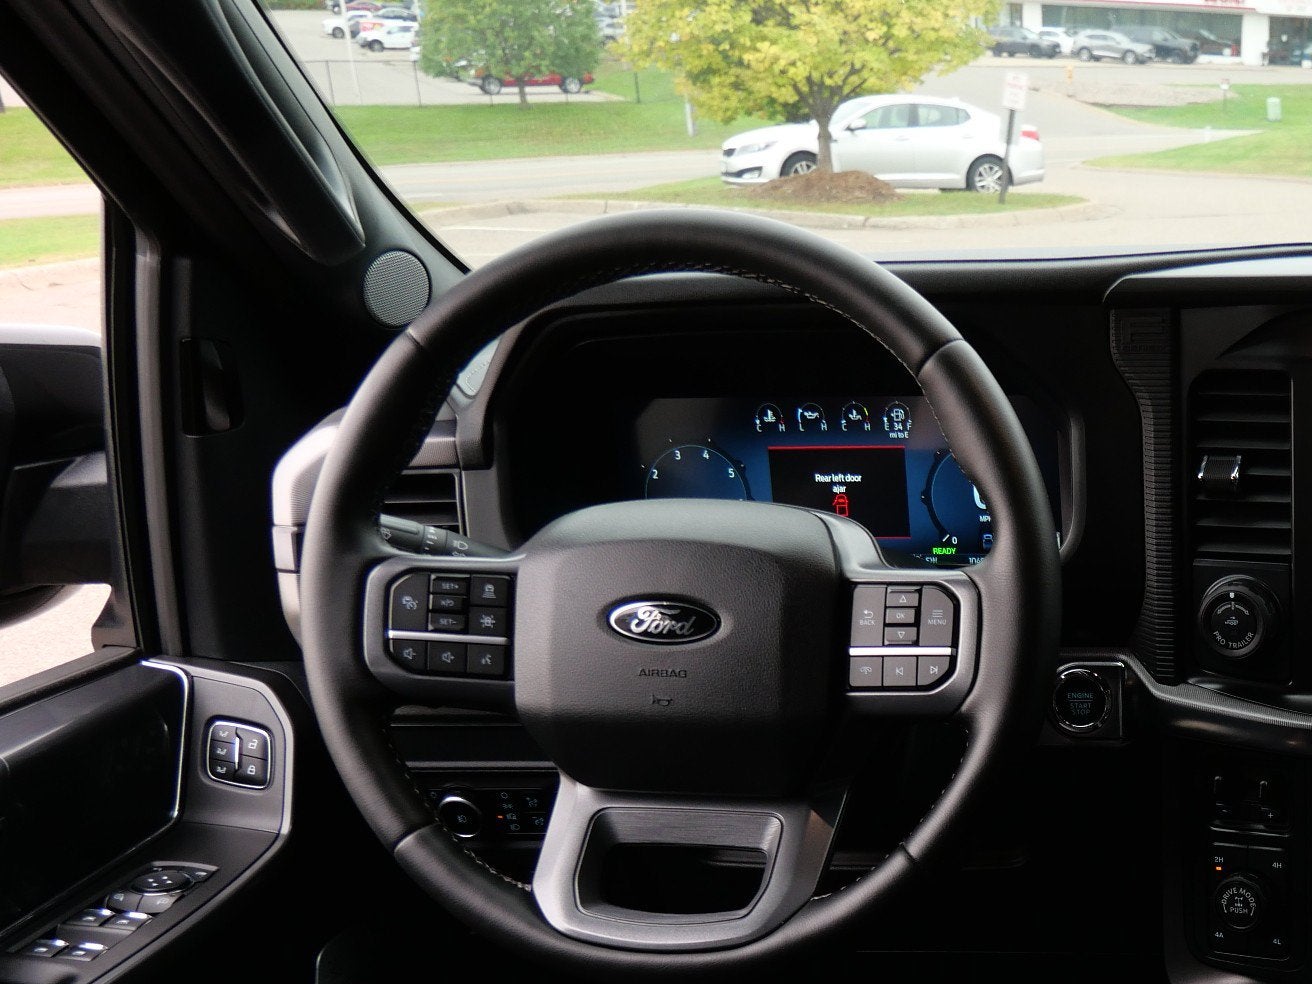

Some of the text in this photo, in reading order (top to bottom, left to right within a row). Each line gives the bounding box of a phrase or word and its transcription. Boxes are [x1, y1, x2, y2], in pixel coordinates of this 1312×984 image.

[674, 450, 682, 460] 3
[702, 450, 709, 460] 4
[651, 469, 659, 479] 2
[728, 469, 735, 478] 5
[815, 473, 862, 483] Rear left door
[833, 484, 847, 494] ajar
[951, 536, 958, 545] 0
[932, 547, 957, 555] READY
[630, 605, 697, 636] Ford
[1213, 630, 1255, 649] PRO TRAILER
[638, 668, 688, 679] AIRBAG
[1221, 886, 1257, 908] DRIVE MODE
